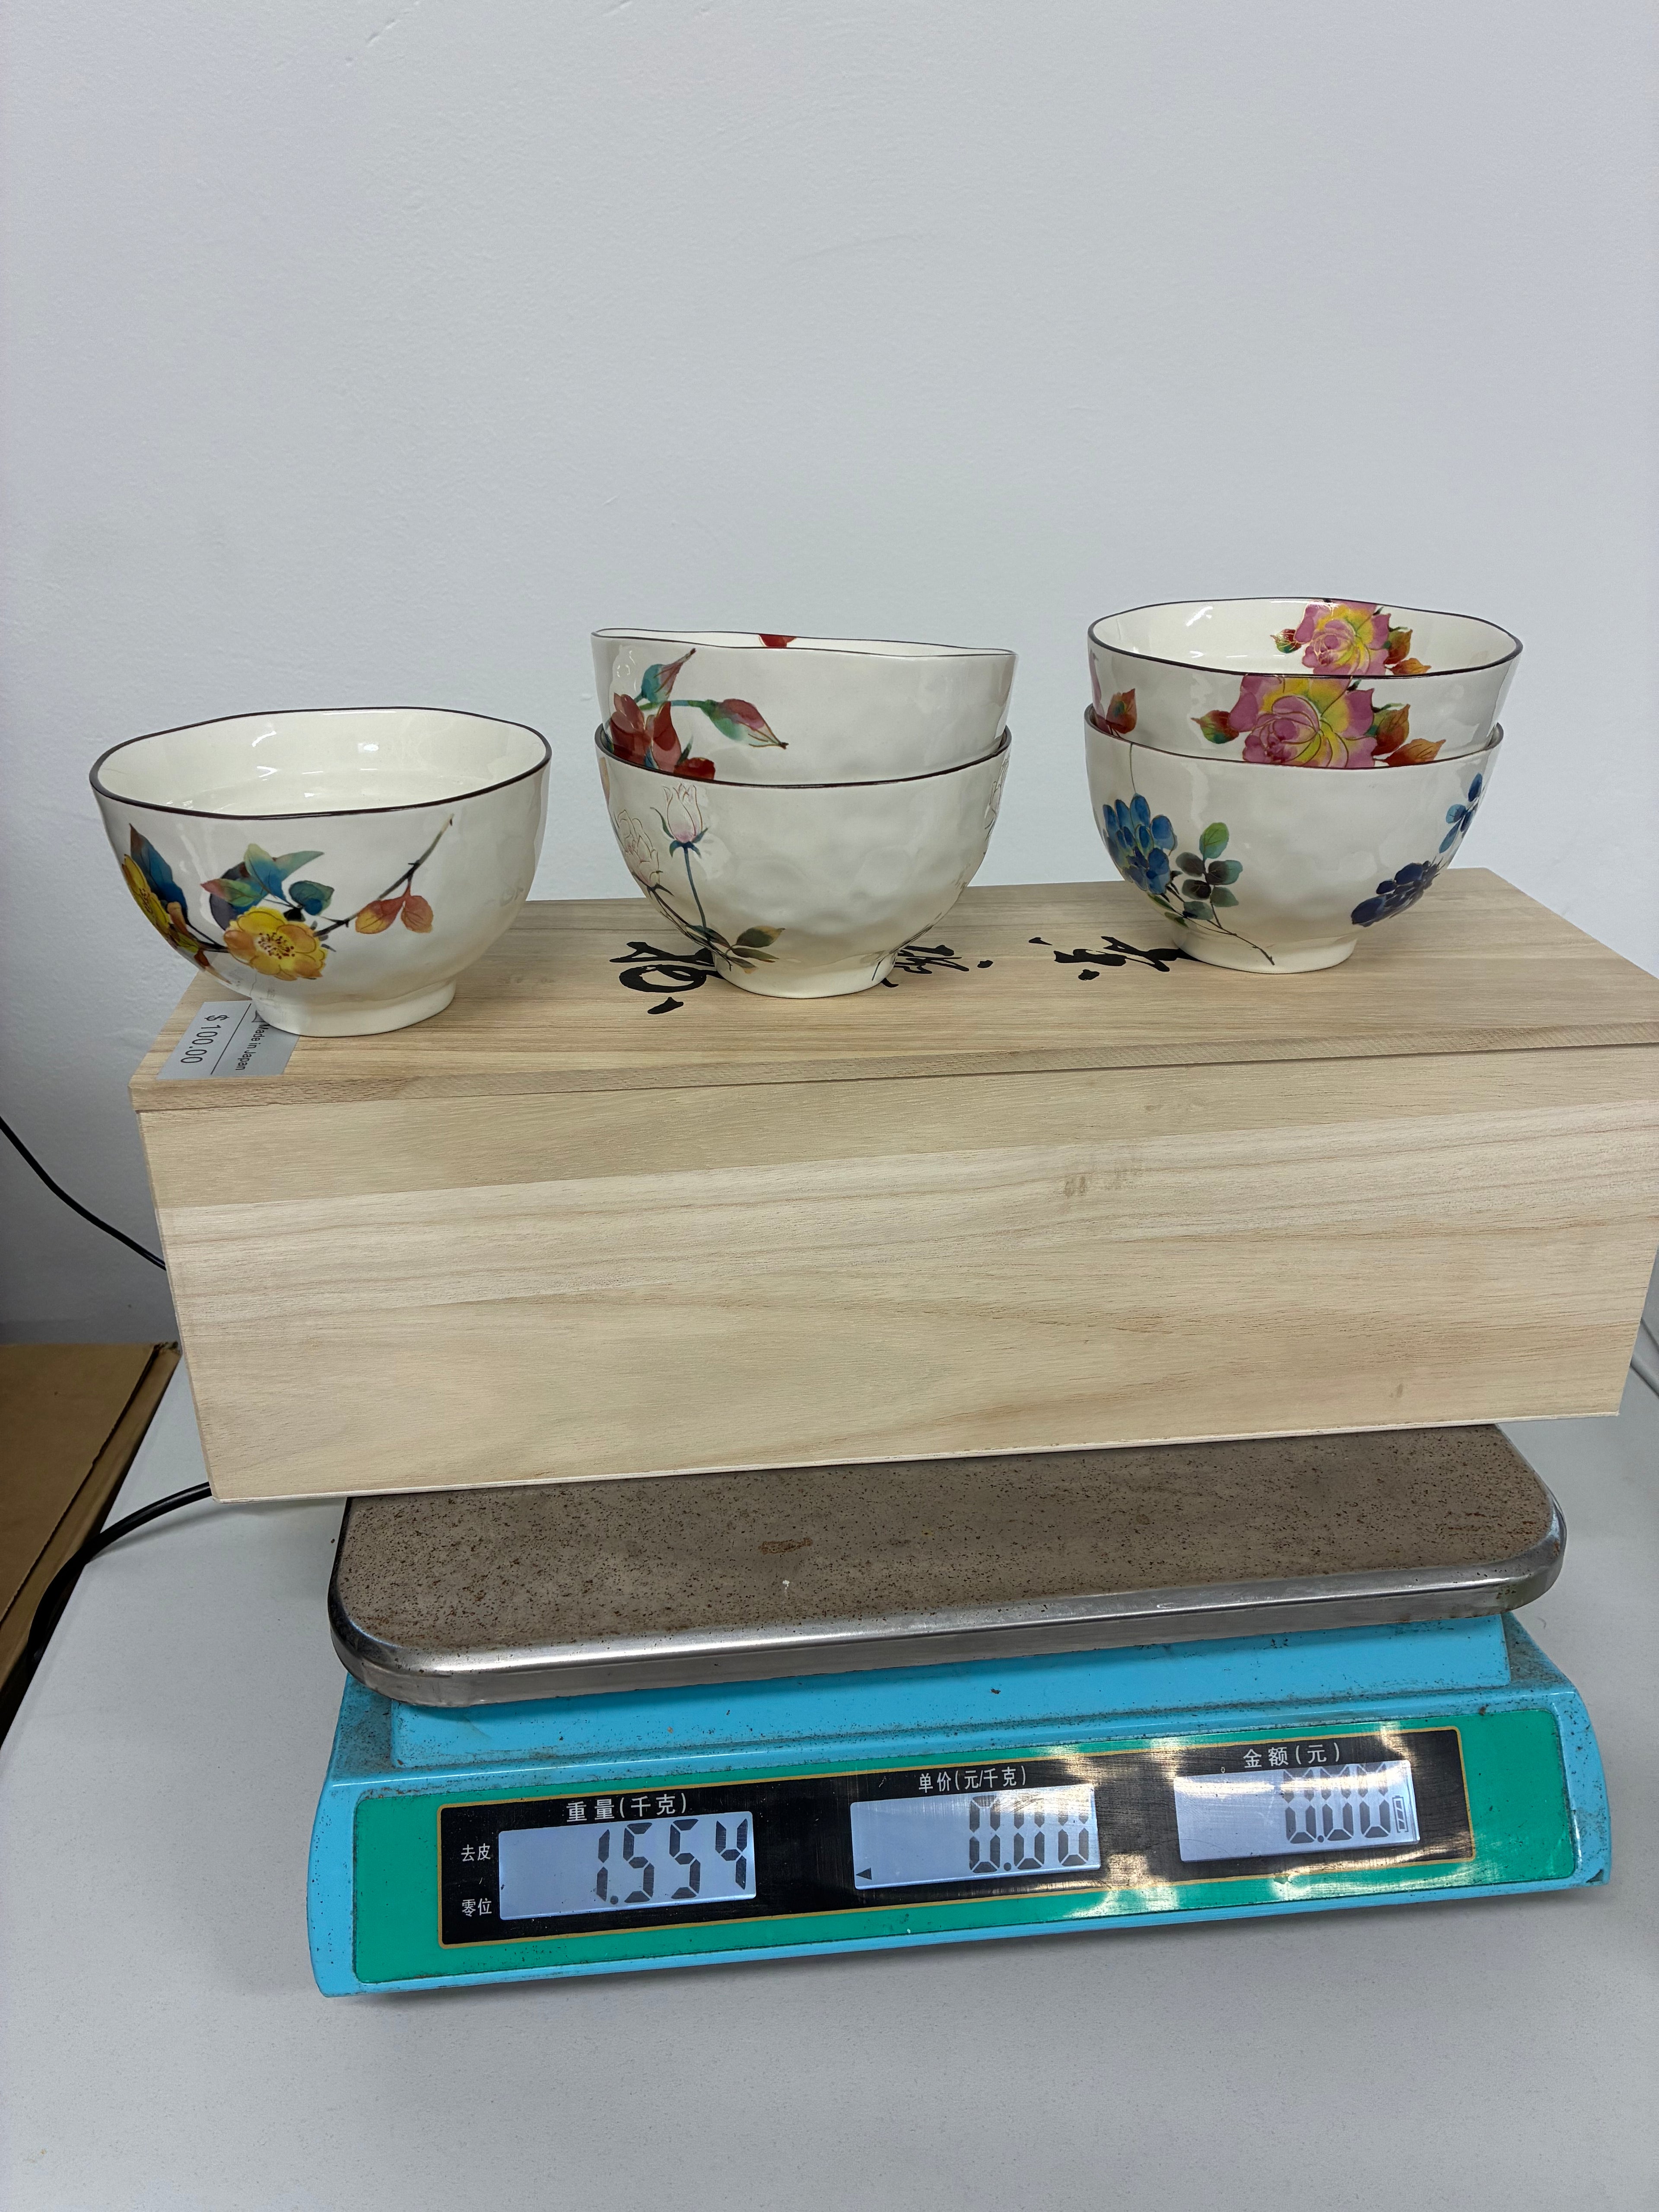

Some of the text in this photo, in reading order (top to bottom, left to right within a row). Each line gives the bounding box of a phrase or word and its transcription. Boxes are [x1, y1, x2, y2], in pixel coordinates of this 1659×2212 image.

[251, 1024, 270, 1041] Made
[235, 1049, 256, 1070] Japan
[461, 1842, 491, 1862] 去皮
[596, 1818, 748, 1905] 1.554
[461, 1897, 492, 1918] 零位
